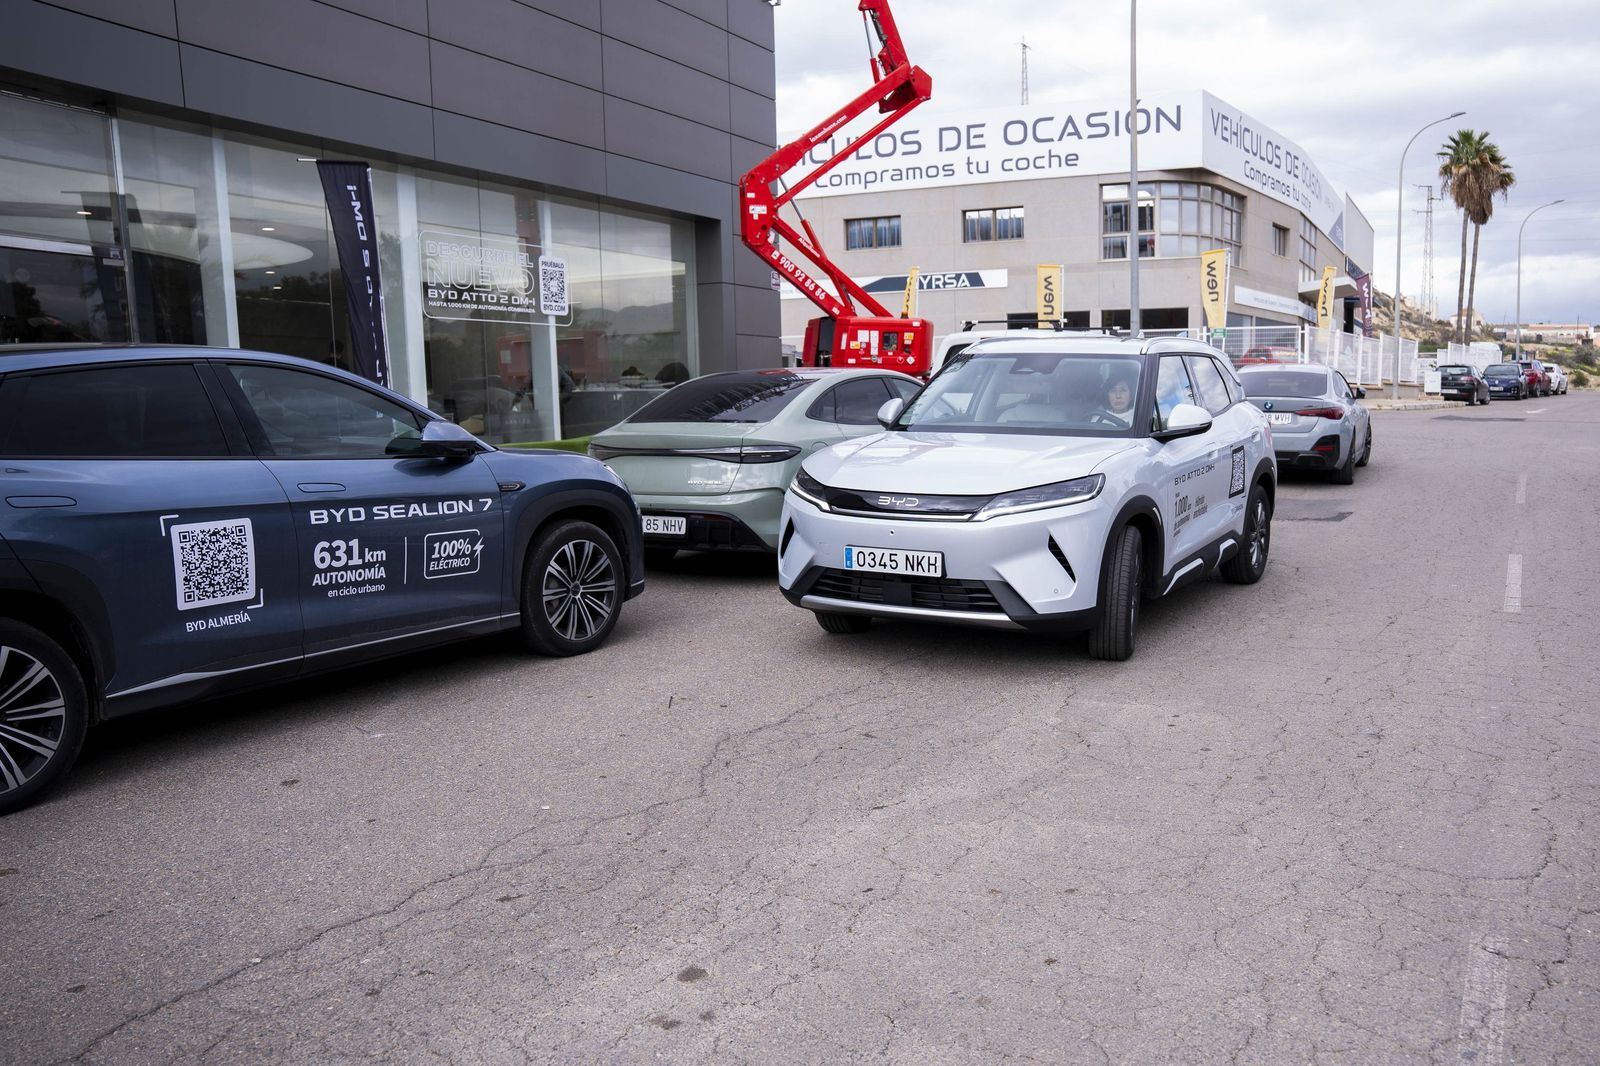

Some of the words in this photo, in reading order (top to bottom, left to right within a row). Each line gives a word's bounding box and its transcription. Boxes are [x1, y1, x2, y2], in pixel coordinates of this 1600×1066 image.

[777, 130, 922, 167] CULOS
[938, 123, 986, 152] DE
[1003, 99, 1181, 146] OCASIÓN
[1211, 107, 1281, 170] VEHÍCULOS
[1285, 150, 1300, 179] DE
[966, 156, 989, 175] tu
[1001, 149, 1079, 172] coche
[1244, 160, 1290, 198] Compramos
[1292, 184, 1300, 202] tu
[516, 251, 534, 269] EL
[541, 260, 565, 269] PRUÉBALO
[426, 257, 535, 295] NUEVO
[779, 255, 795, 273] 900
[794, 269, 804, 282] 92
[804, 279, 815, 291] 86
[815, 289, 826, 300] 86
[907, 272, 970, 291] YRSA
[427, 288, 458, 300] BYD
[461, 291, 498, 303] ATTO
[500, 295, 509, 304] 2
[428, 300, 448, 308] HASTA
[543, 304, 566, 313] BYD.COM
[1175, 474, 1186, 486] BYD
[1187, 469, 1201, 480] ATTO
[309, 507, 366, 525] BYD
[373, 499, 473, 520] SEALION
[478, 498, 493, 512] 7
[878, 495, 919, 507] BYD
[645, 518, 659, 532] 85
[662, 518, 684, 533] NHV
[314, 538, 363, 570] 631
[364, 548, 386, 563] km
[431, 538, 472, 559] 100%
[429, 557, 471, 571] ELÉCTRICO
[856, 552, 898, 570] 0345
[904, 554, 938, 574] NKH
[312, 564, 386, 586] AUTONOMÍA
[327, 589, 338, 598] en
[339, 585, 357, 596] ciclo
[358, 583, 386, 594] urbano
[186, 620, 207, 632] BYD
[208, 610, 251, 629] ALMERÍA
